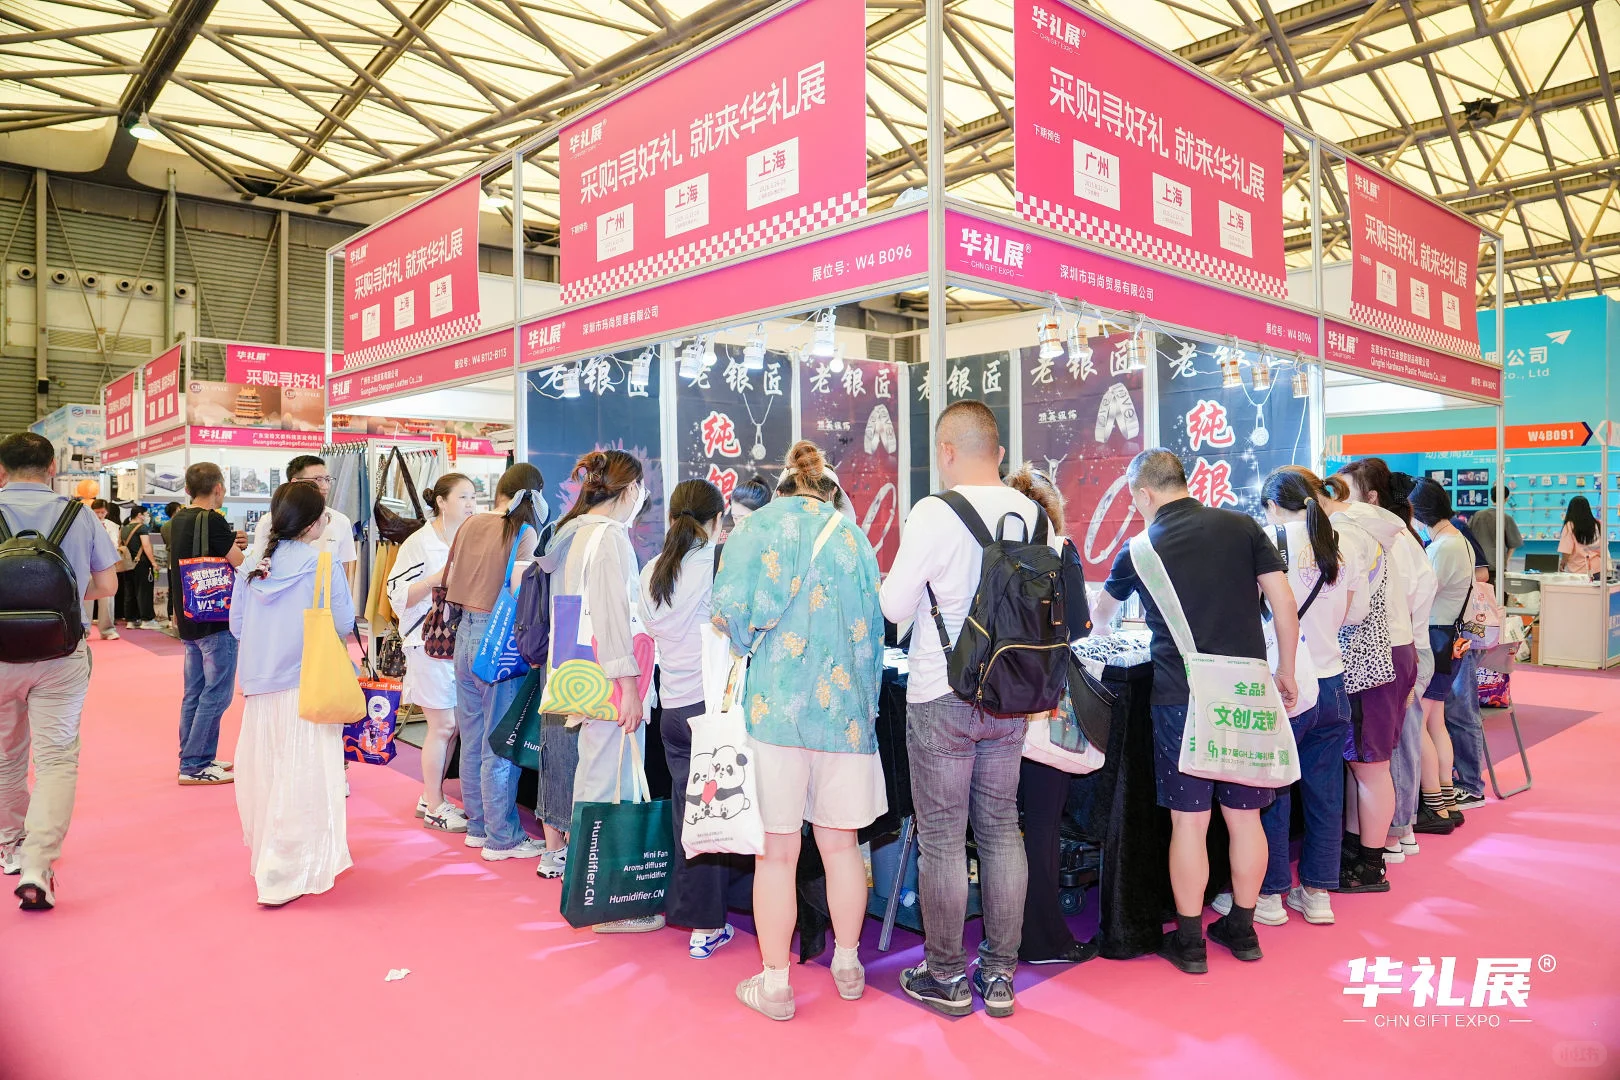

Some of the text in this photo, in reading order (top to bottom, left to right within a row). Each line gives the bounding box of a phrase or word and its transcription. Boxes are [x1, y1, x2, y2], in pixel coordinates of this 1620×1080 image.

[1032, 5, 1080, 49] 华礼展
[569, 122, 602, 153] 华礼展
[580, 60, 826, 204] 采购寻好礼 就来华礼展
[1033, 123, 1061, 144] 下期预告
[1049, 66, 1265, 202] 采购寻好礼 就来华礼展
[606, 149, 786, 235] 广州 上海 上海
[1085, 151, 1244, 231] 广州 上海 上海
[855, 252, 876, 270] W4
[879, 246, 913, 267] B096
[960, 228, 1024, 269] 华礼展
[1365, 213, 1468, 289] 采购寻好礼 就来华礼展
[354, 228, 463, 300] 采购寻好礼 就来华礼展
[1059, 264, 1154, 301] 深圳市玛尚贸易有限公司
[528, 323, 562, 350] 华礼展
[1287, 329, 1297, 339] W4
[1328, 331, 1356, 354] 华礼展
[246, 369, 325, 390] 采购寻好礼
[1528, 368, 1550, 378] Ltd
[1528, 429, 1574, 442] W4B091
[584, 820, 602, 906] Humidifier.CN
[623, 861, 667, 872] Aroma diffuser
[643, 851, 656, 859] Mini
[635, 871, 667, 881] Humidifier
[609, 889, 664, 904] Humidifier.CN
